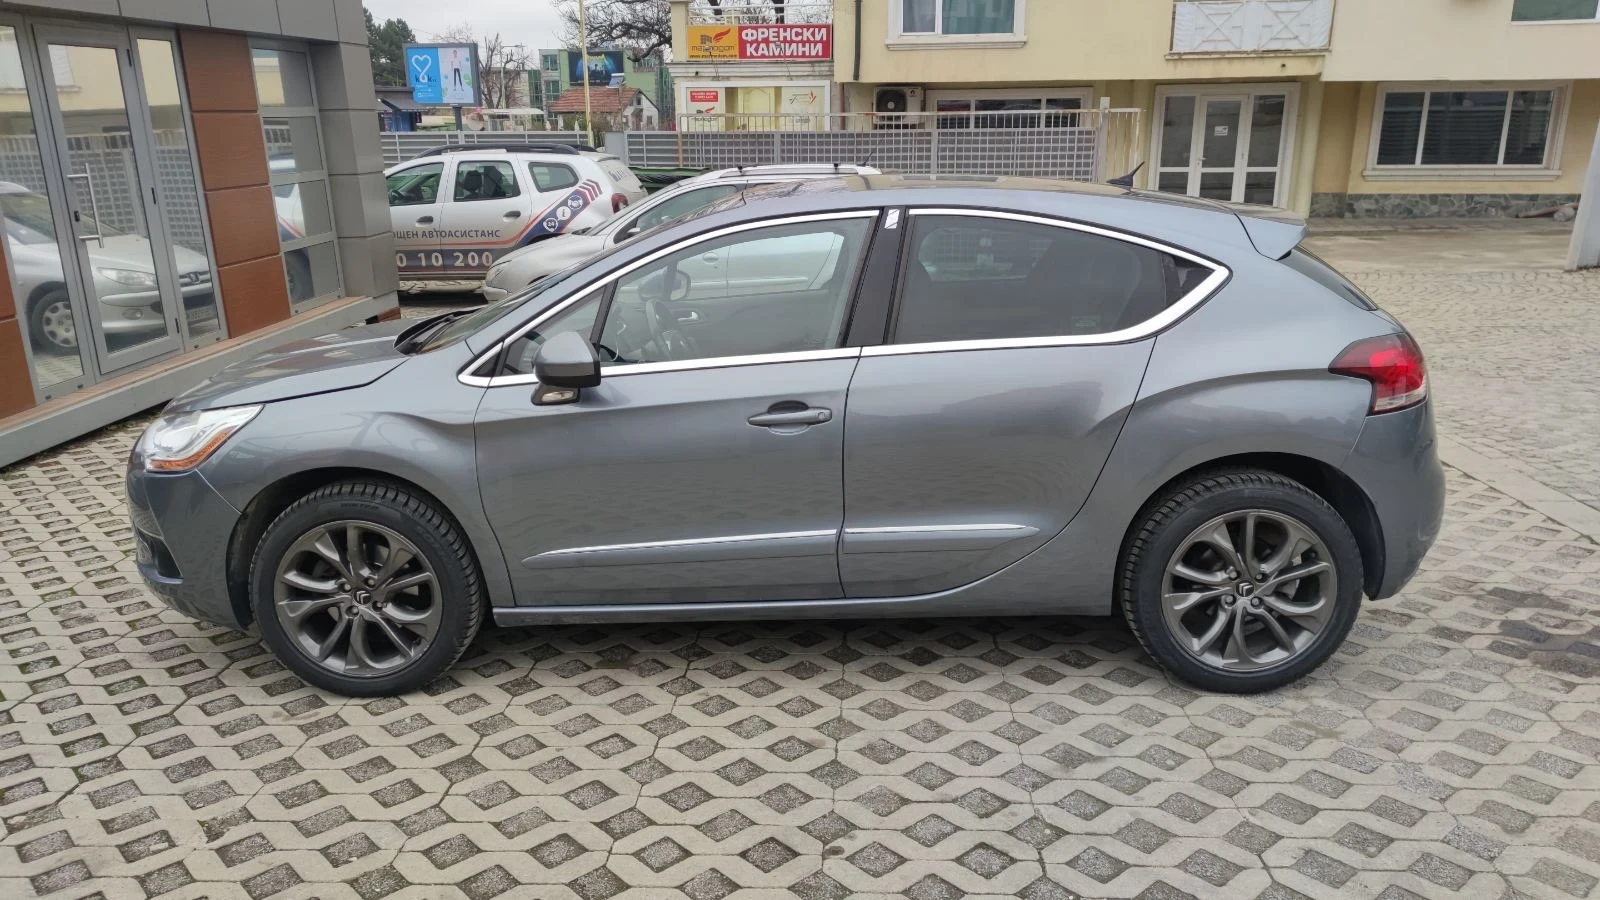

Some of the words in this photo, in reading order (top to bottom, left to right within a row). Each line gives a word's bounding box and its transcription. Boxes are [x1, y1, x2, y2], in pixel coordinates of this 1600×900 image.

[741, 27, 827, 41] ФРЕНСКИ
[746, 42, 823, 57] КАМИНИ
[393, 230, 419, 240] ЩЕН
[421, 229, 501, 239] АВТОАСИСТАНС
[418, 252, 443, 267] 10
[453, 251, 493, 267] 200
